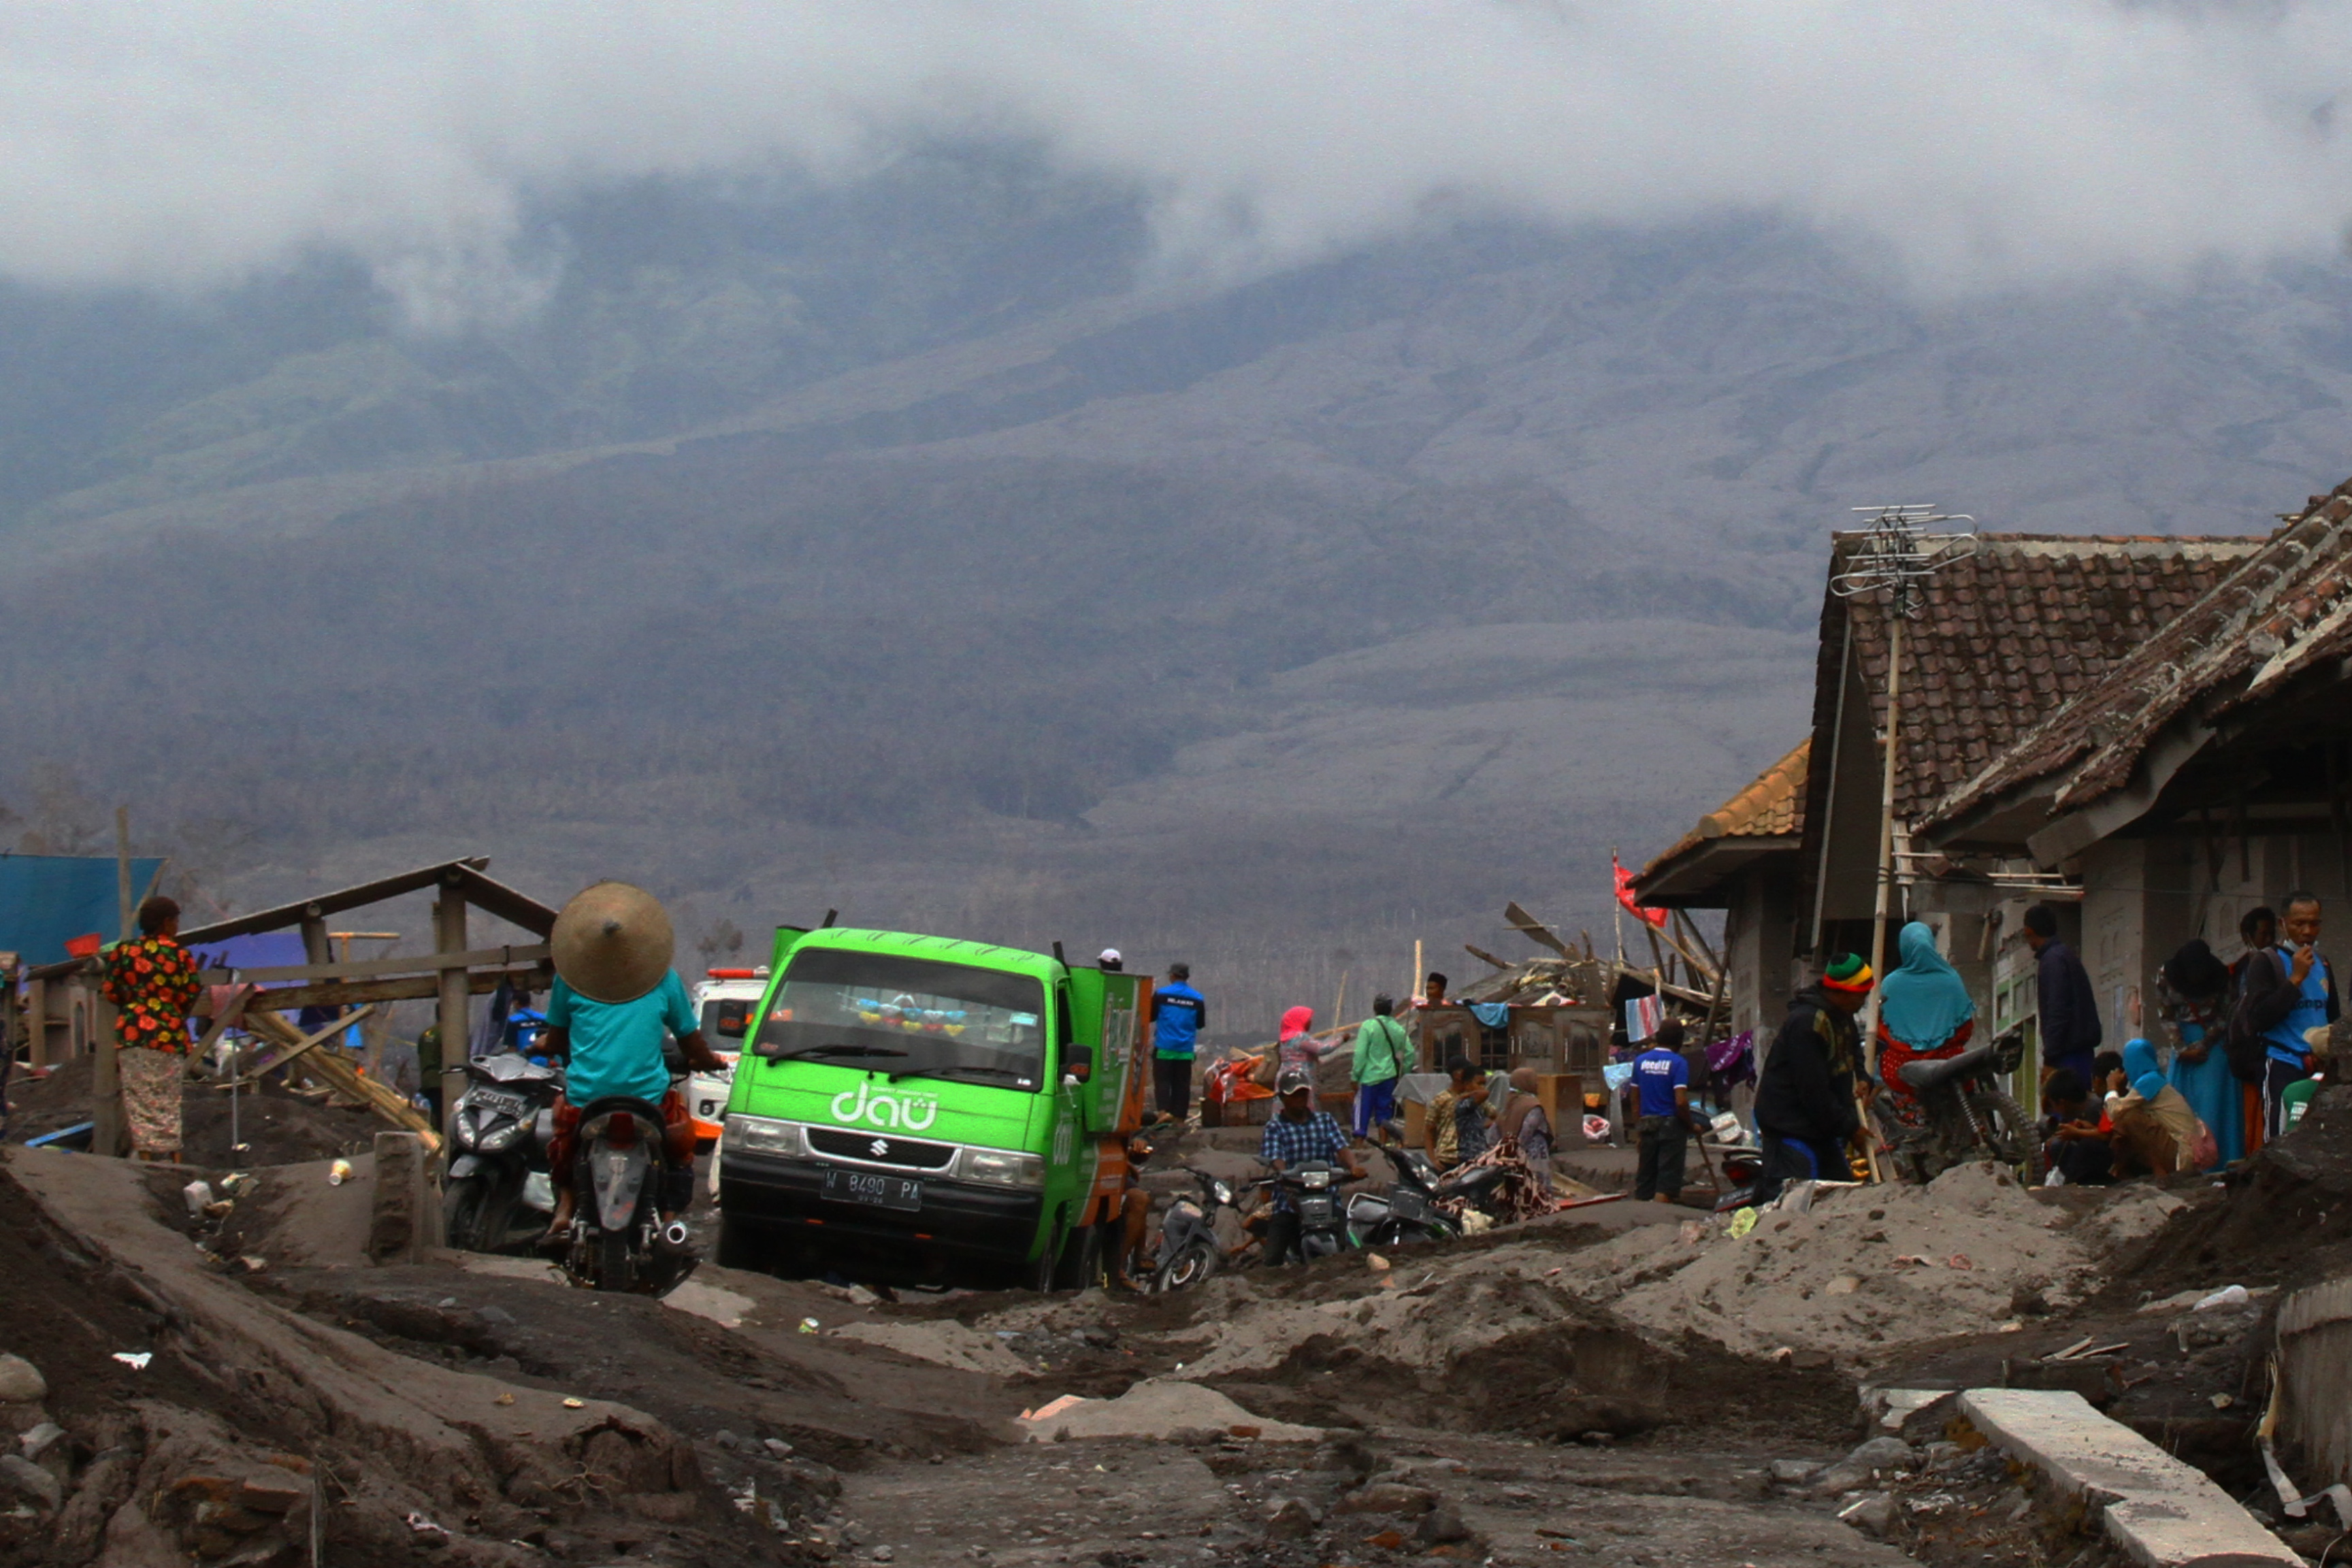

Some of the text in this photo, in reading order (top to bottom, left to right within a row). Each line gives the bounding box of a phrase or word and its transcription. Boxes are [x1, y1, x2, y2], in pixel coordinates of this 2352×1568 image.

[826, 1171, 919, 1200] W 8490 PA
